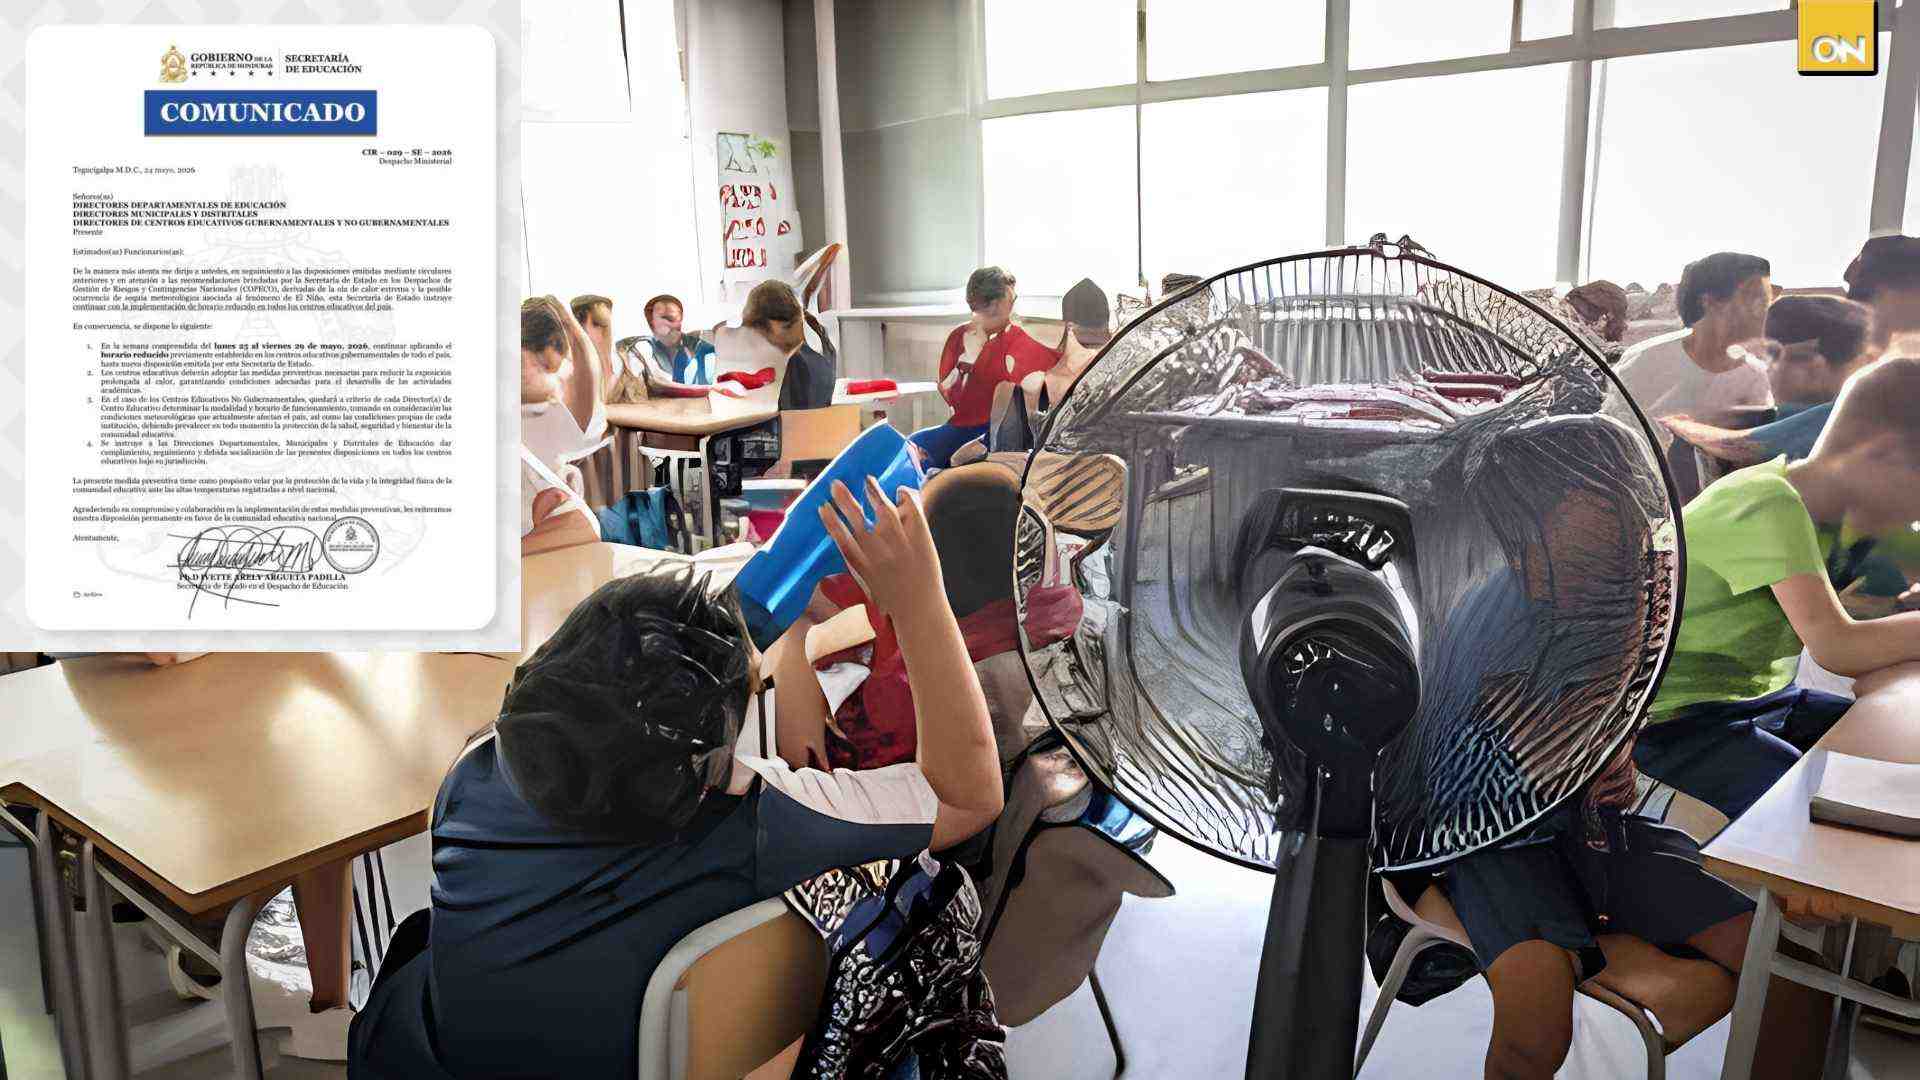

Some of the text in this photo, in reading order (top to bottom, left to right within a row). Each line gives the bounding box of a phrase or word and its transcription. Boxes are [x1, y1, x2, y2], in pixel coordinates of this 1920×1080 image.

[191, 53, 253, 62] GOBIERNO
[285, 53, 349, 63] SECRETARÍA
[286, 64, 362, 73] DE EDUCACIÓN
[160, 102, 366, 122] COMUNICADO
[379, 158, 412, 166] Despacho
[174, 268, 193, 276] dirijo
[404, 276, 441, 285] Despachos
[113, 286, 139, 294] Riesgos
[240, 286, 279, 294] (COPECO),
[427, 286, 452, 294] posible
[410, 342, 443, 351] aplicando
[267, 582, 301, 591] Despacho
